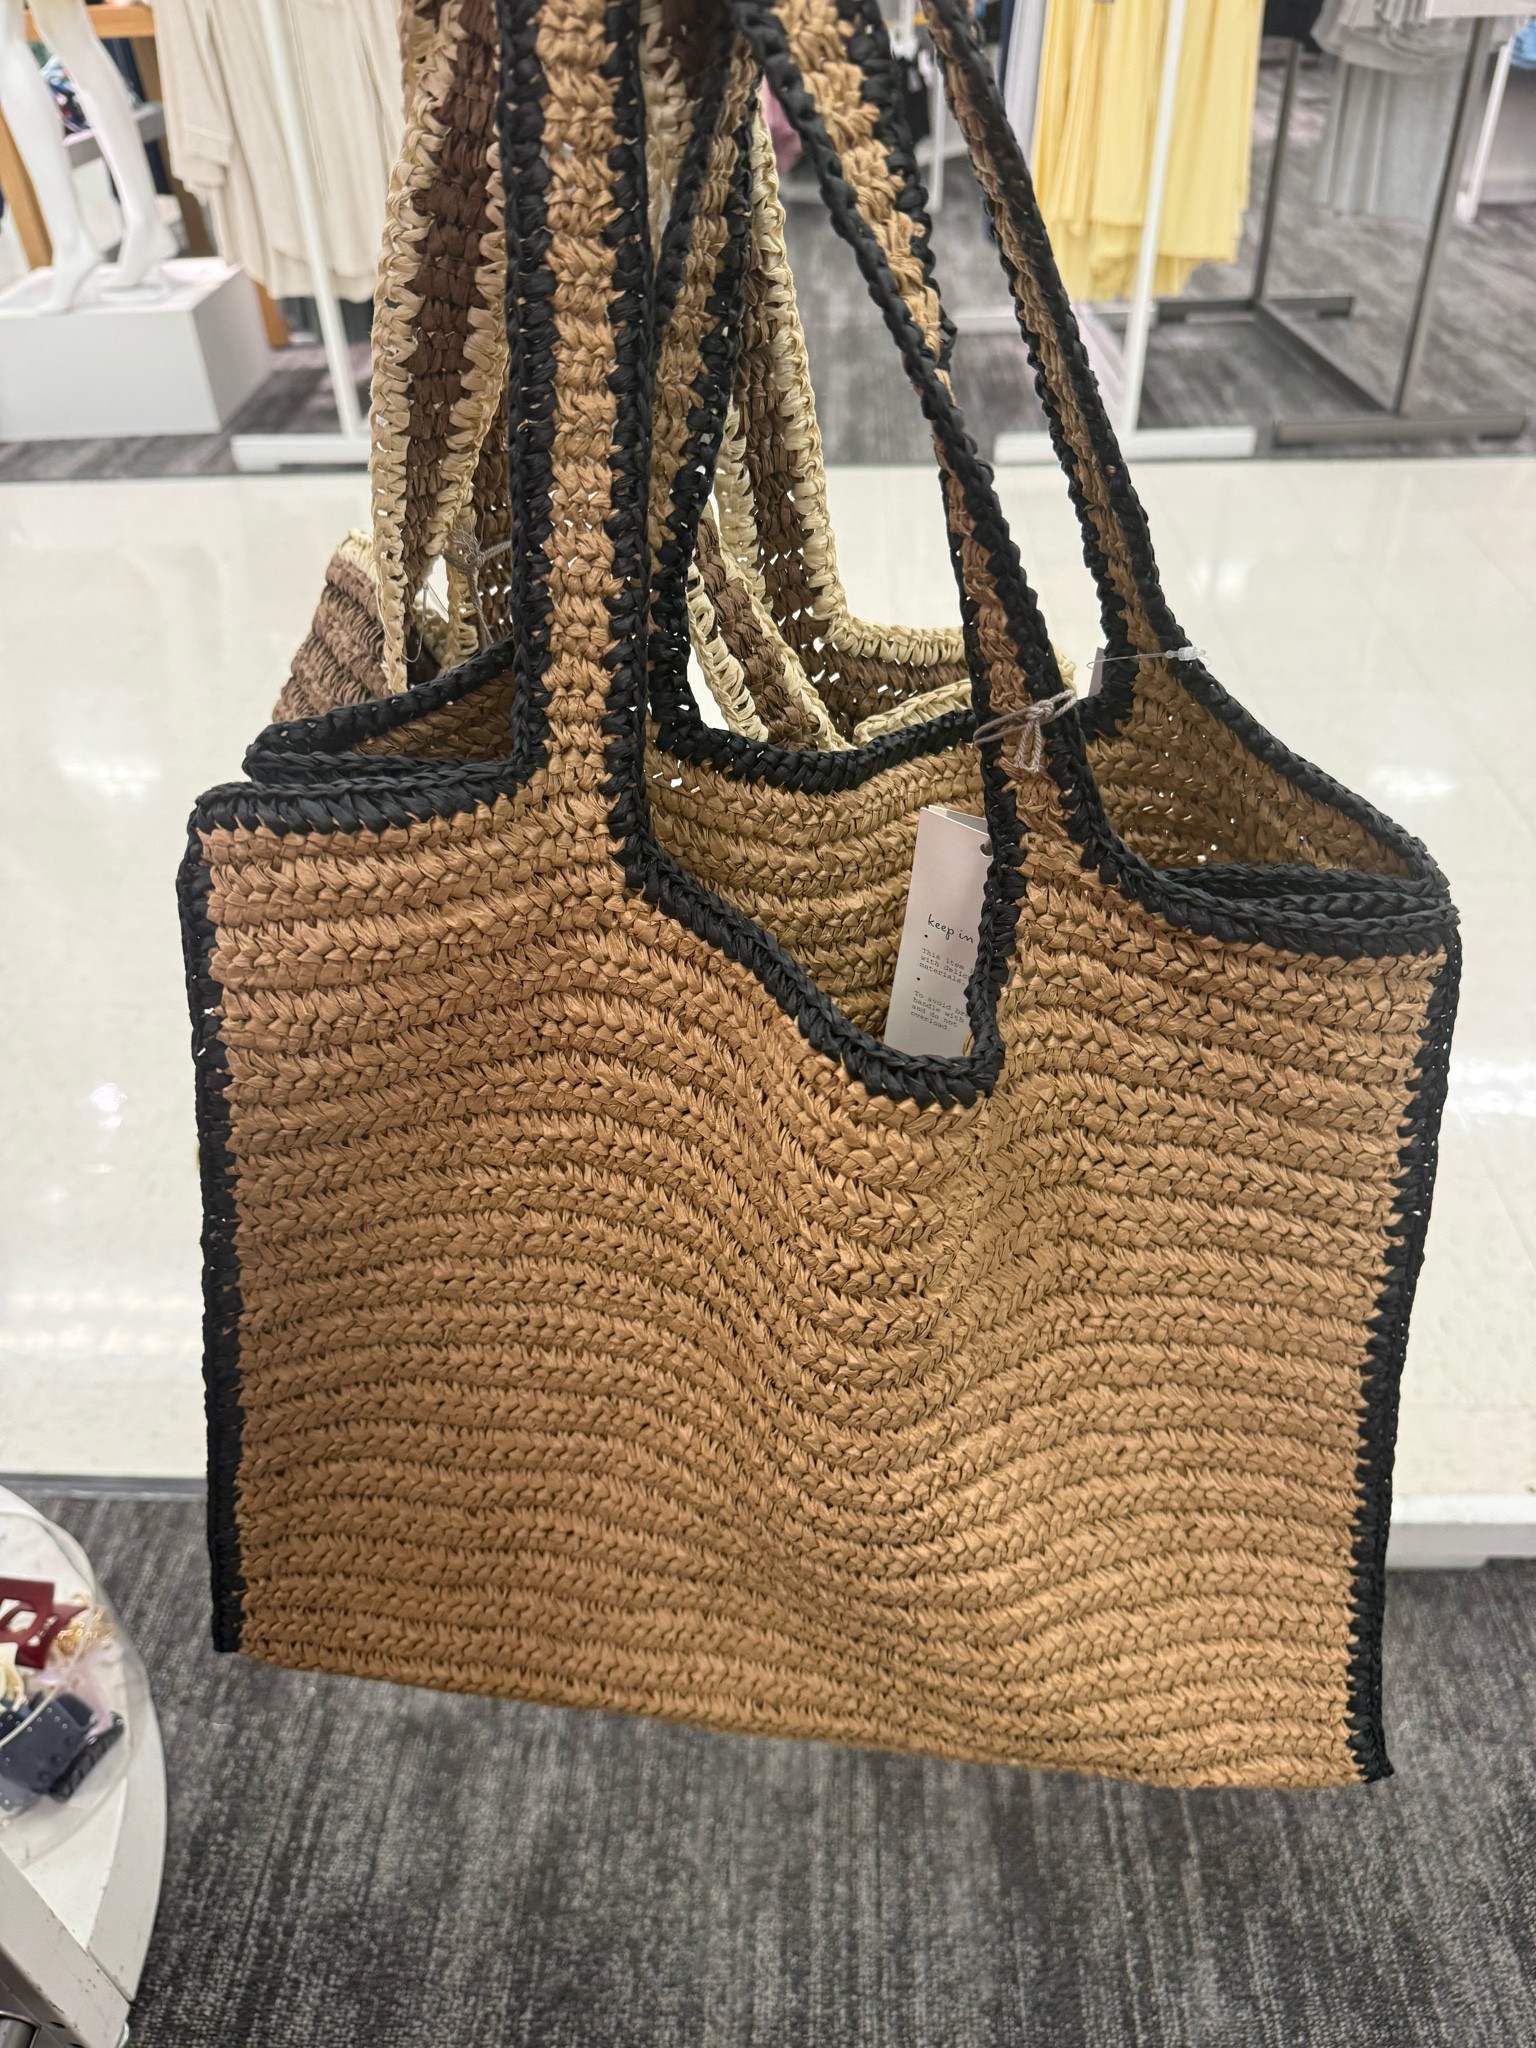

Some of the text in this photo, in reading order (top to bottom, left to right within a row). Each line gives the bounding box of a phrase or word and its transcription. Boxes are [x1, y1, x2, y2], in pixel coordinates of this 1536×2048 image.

[928, 914, 973, 943] keep in
[921, 956, 969, 979] with delic
[922, 948, 940, 960] This
[946, 958, 964, 970] item
[919, 963, 965, 985] materials.
[913, 997, 964, 1023] handle with
[914, 990, 968, 1018] To avoid br
[911, 1005, 926, 1013] and
[944, 1018, 957, 1027] not
